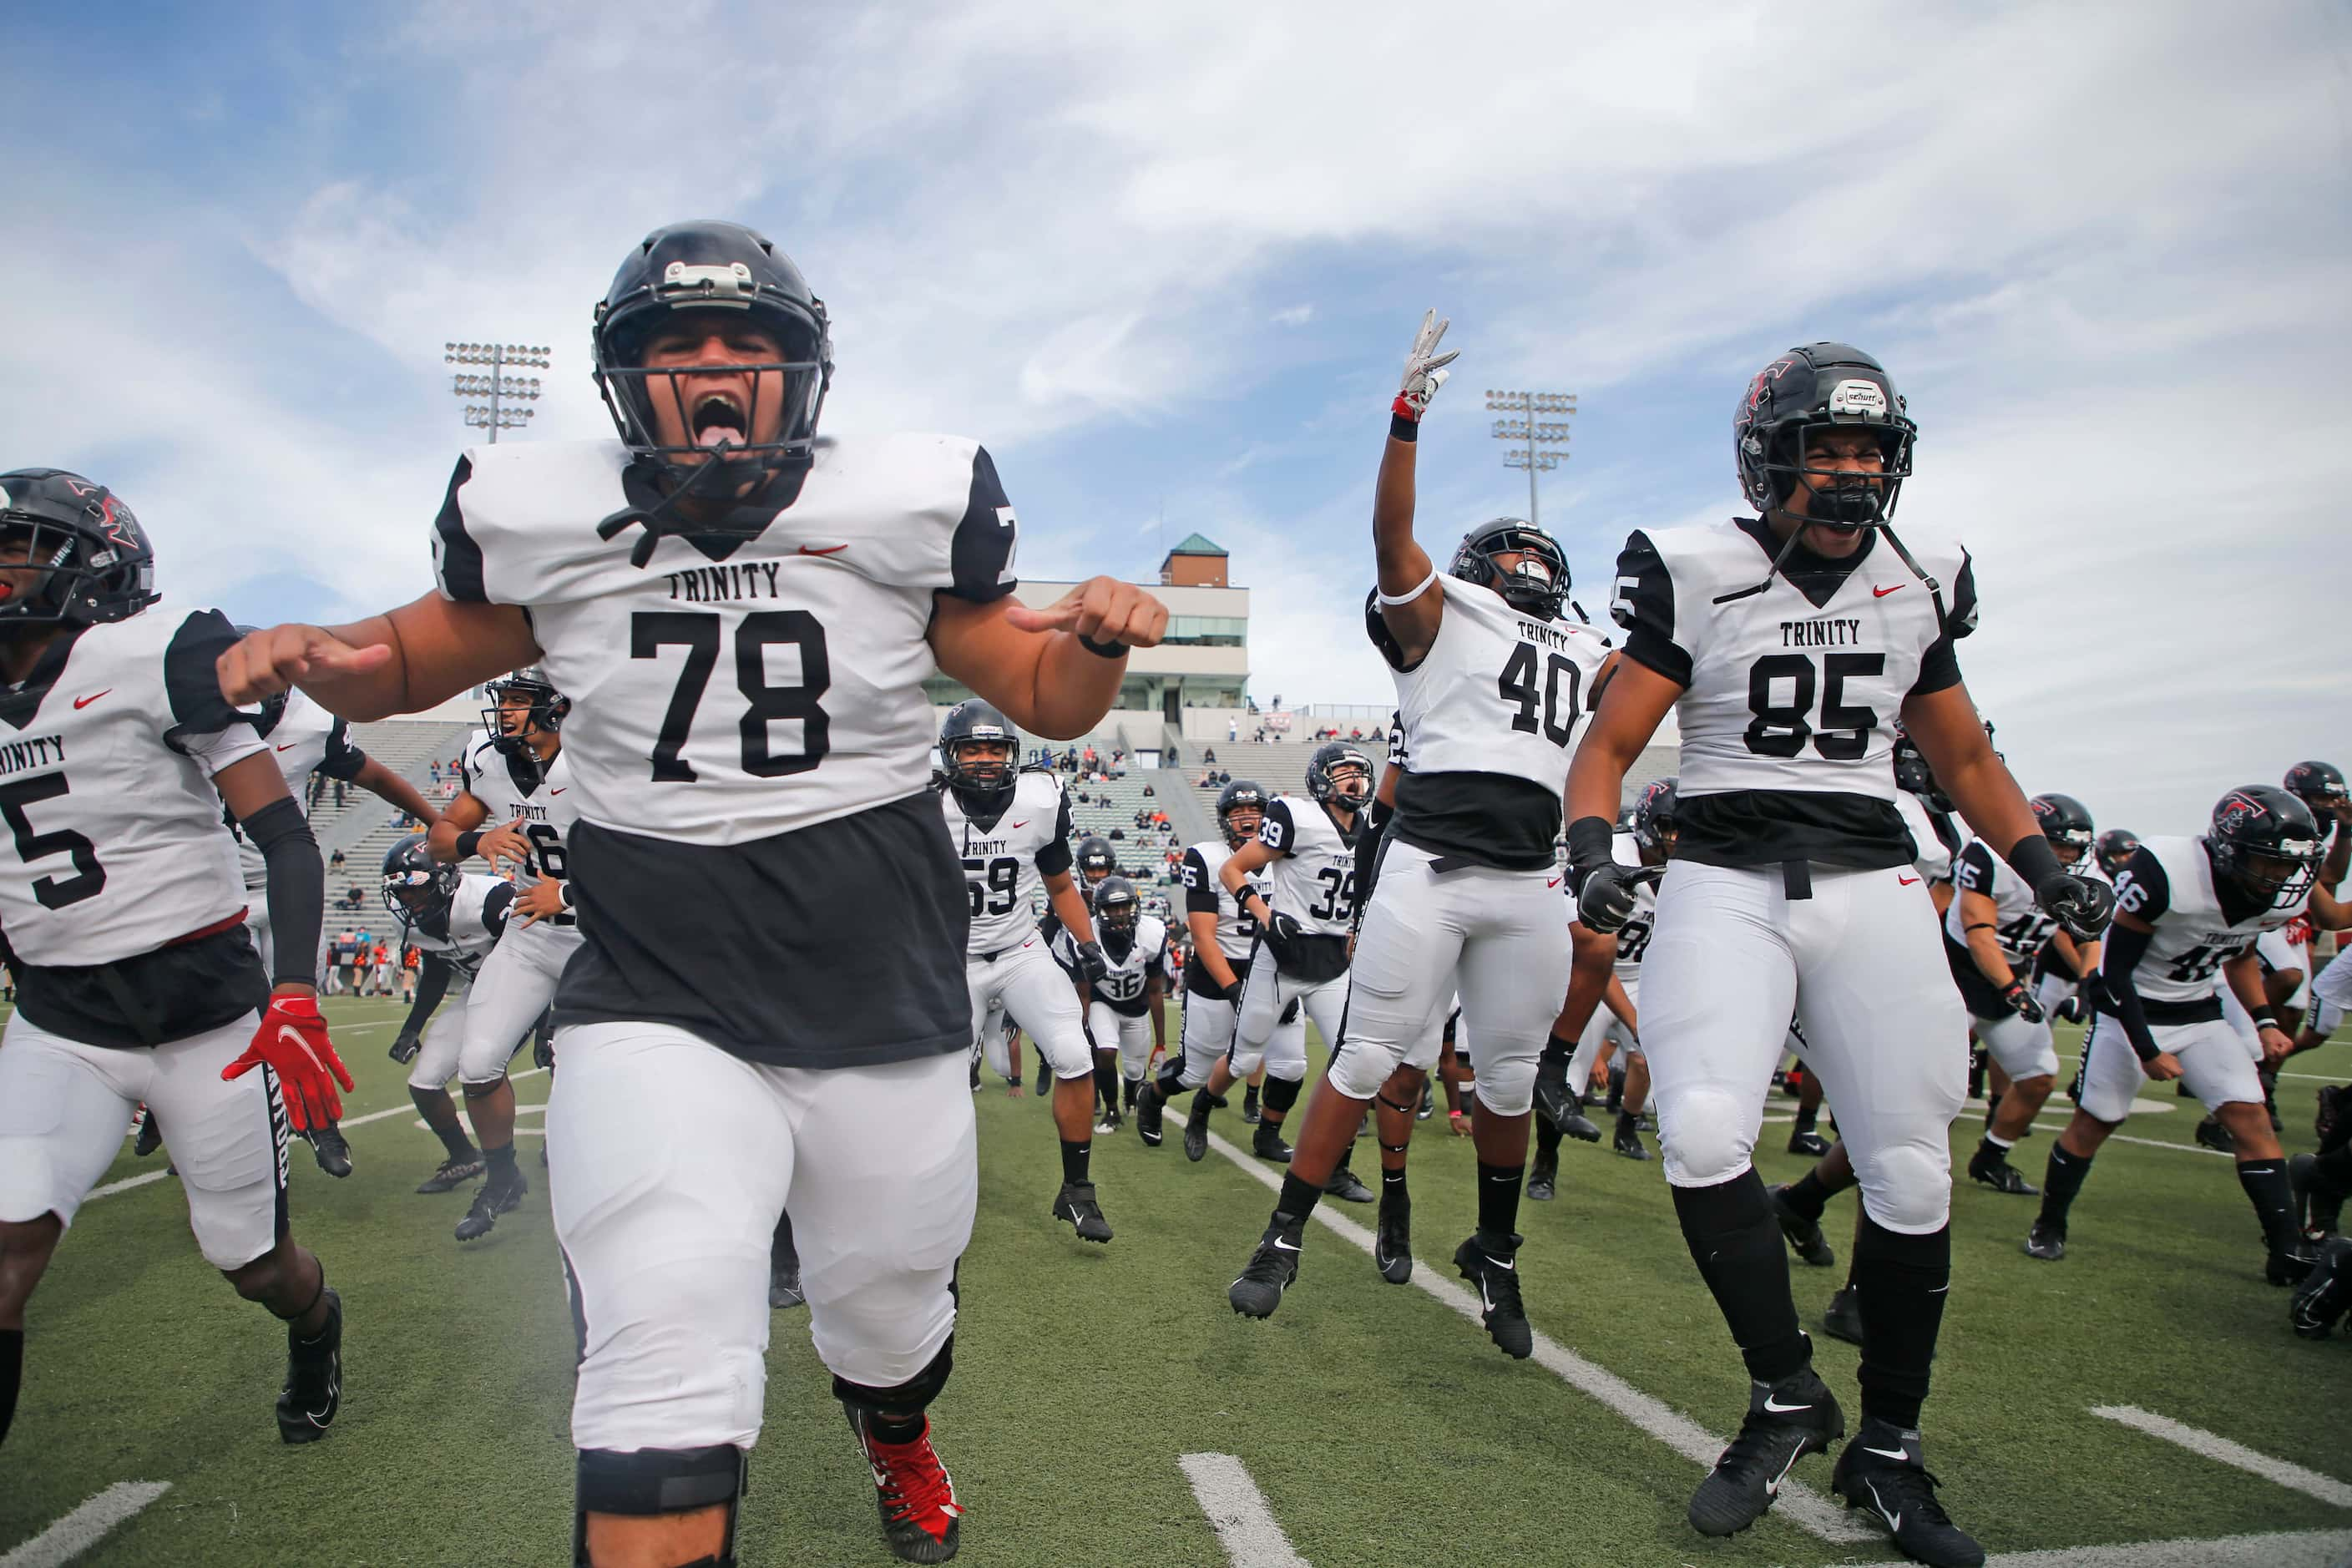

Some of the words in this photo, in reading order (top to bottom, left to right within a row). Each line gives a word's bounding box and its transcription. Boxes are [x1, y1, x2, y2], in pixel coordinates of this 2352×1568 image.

[662, 562, 780, 602] TRINITY
[1517, 620, 1568, 652] TRINITY
[1780, 620, 1860, 647] TRINITY
[630, 609, 832, 783] 78
[1498, 641, 1581, 749] 40
[1743, 653, 1886, 760] 85
[509, 803, 547, 821] TRINITY
[1257, 817, 1284, 848] 39
[0, 771, 107, 911] 5
[968, 840, 1007, 856] TRINITY
[960, 857, 1019, 917] 59
[1309, 867, 1355, 921] 39
[2113, 869, 2149, 913] 46
[1103, 973, 1141, 999] 36
